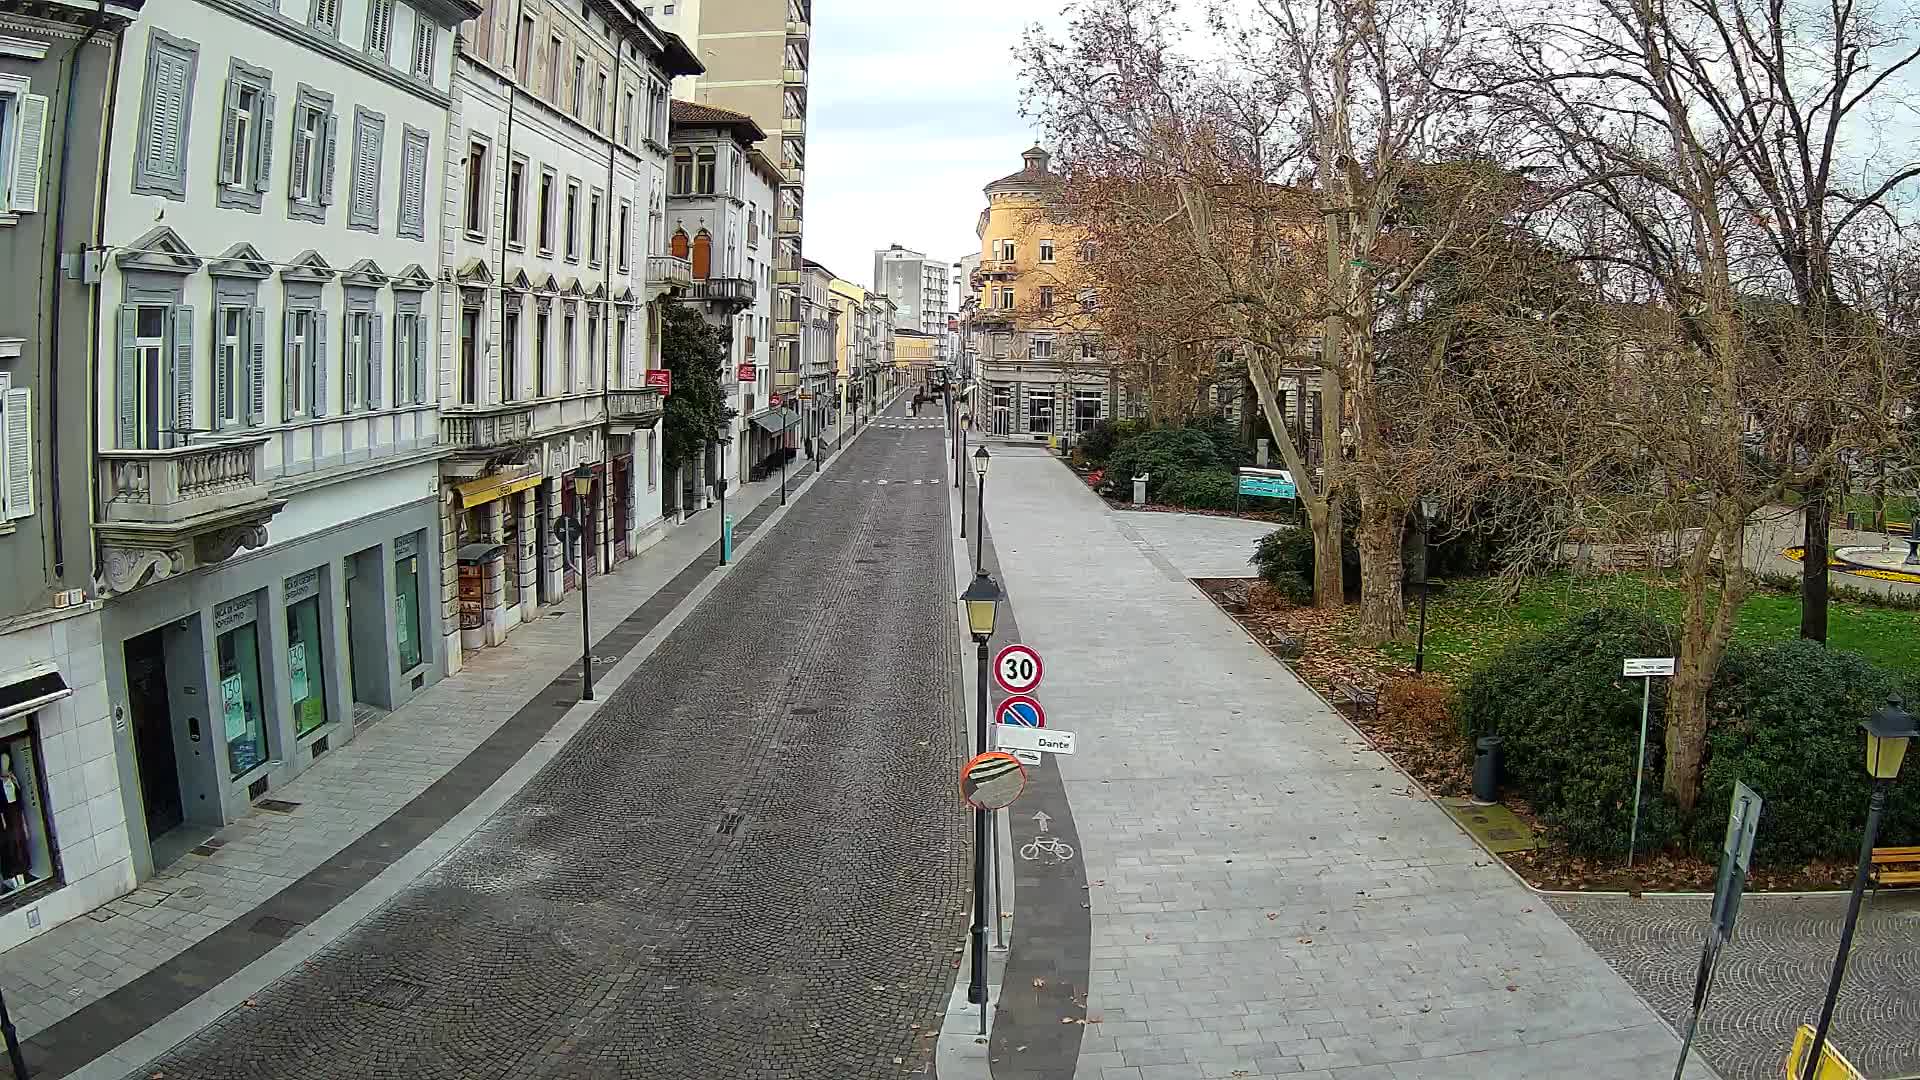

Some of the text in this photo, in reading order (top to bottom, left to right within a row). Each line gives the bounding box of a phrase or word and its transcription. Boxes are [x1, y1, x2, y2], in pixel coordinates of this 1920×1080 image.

[1005, 658, 1033, 680] 30
[223, 677, 240, 700] 130
[1038, 738, 1070, 749] Dante
